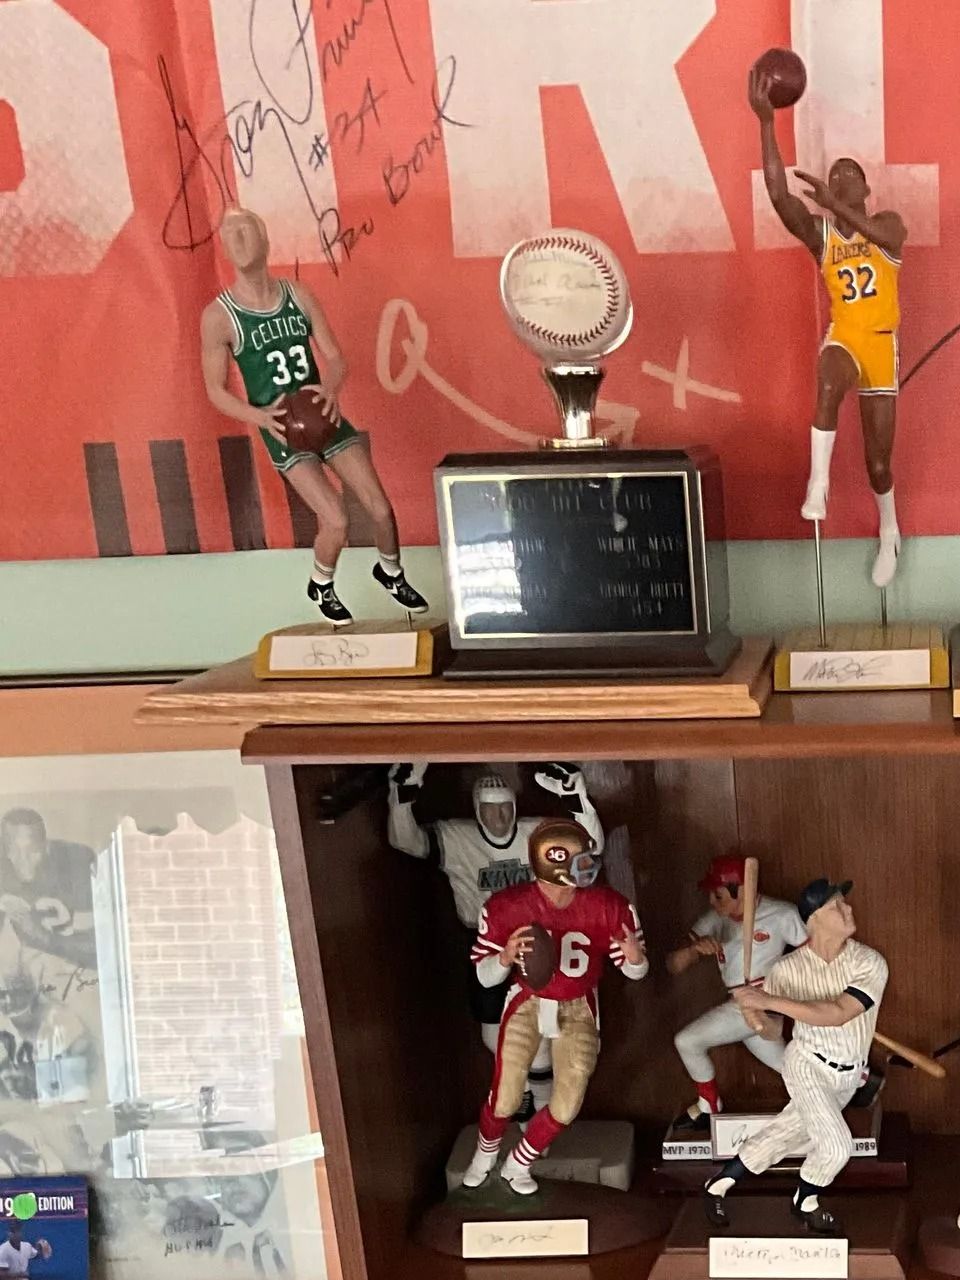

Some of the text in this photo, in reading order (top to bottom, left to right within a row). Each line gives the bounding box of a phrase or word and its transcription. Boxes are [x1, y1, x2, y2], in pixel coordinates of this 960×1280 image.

[837, 264, 878, 304] 32
[251, 315, 307, 350] CELTICS
[266, 344, 310, 386] 33
[547, 849, 567, 862] 16
[547, 930, 591, 978] 6
[663, 1145, 684, 1155] MVP
[855, 1142, 876, 1152] 1989
[38, 1196, 75, 1211] EDITION
